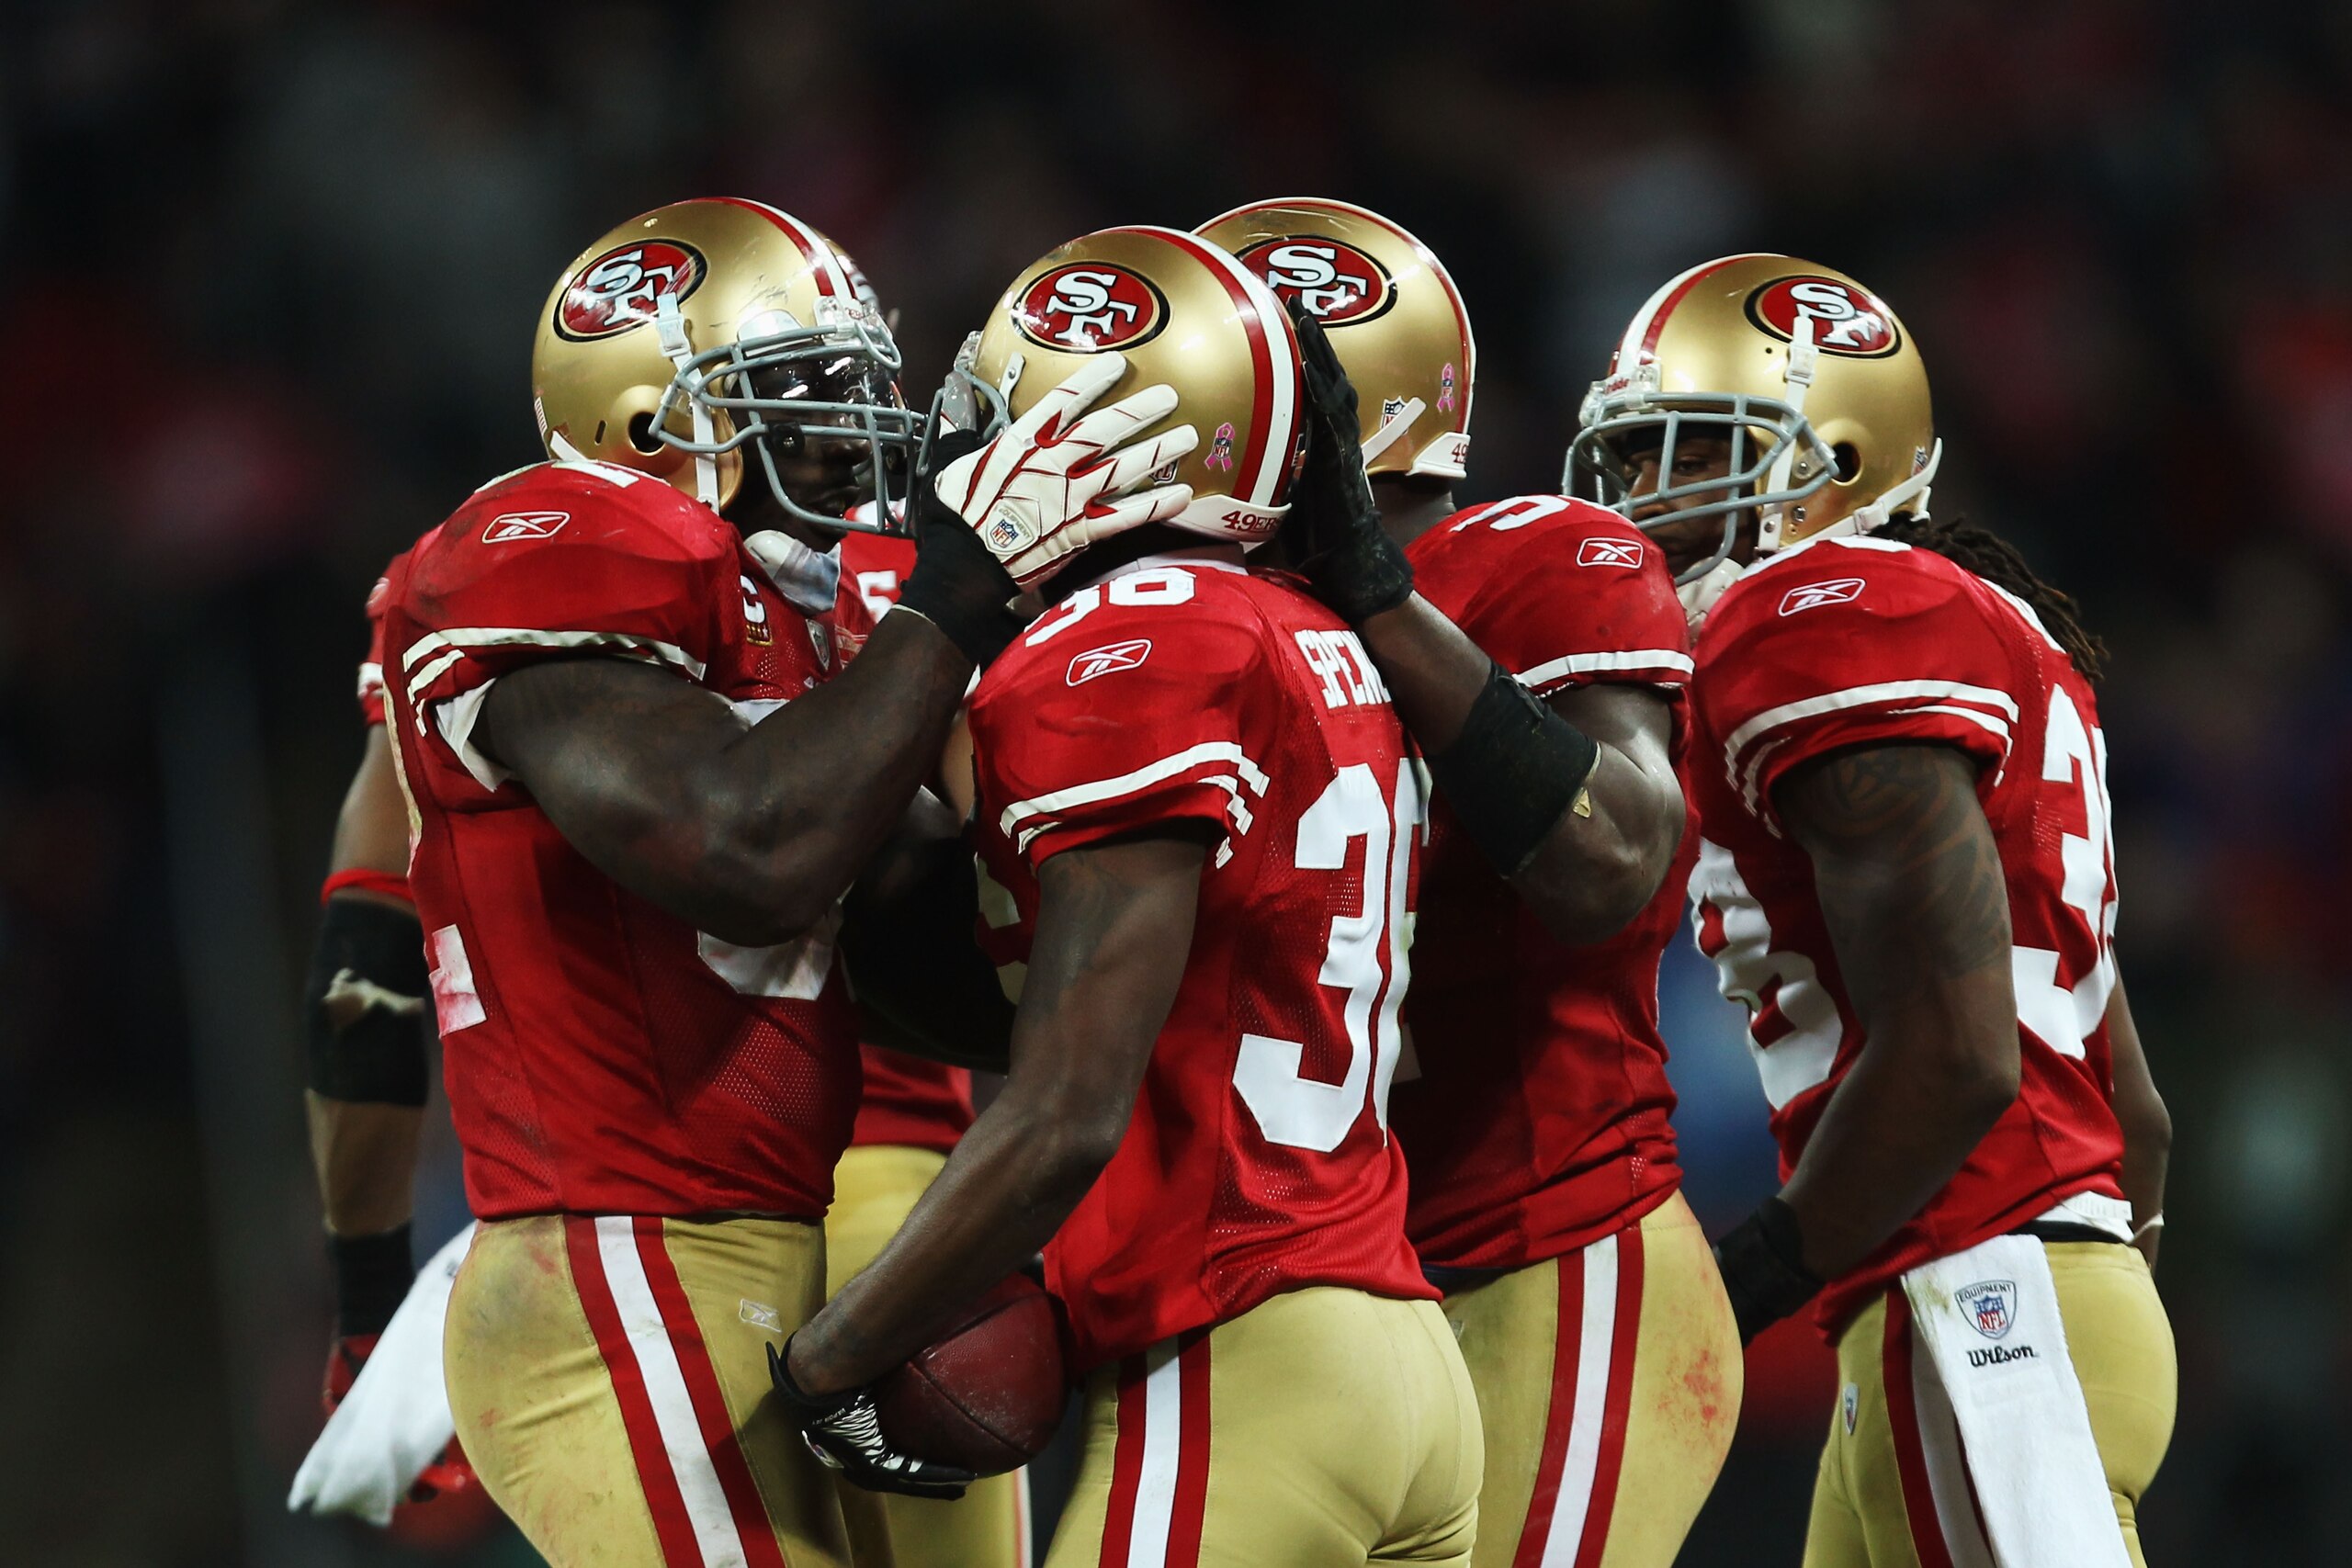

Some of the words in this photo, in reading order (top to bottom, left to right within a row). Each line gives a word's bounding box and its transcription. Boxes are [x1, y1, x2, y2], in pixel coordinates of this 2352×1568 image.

[583, 249, 673, 326] SF
[1267, 244, 1367, 316] SF
[1046, 271, 1137, 346] SF
[1790, 282, 1883, 347] SF
[1221, 510, 1280, 534] 49ER
[992, 525, 1012, 546] NFL
[1958, 1282, 2012, 1303] EQUIPMENT
[1978, 1311, 2006, 1330] NFL
[1966, 1345, 2035, 1368] Wilson
